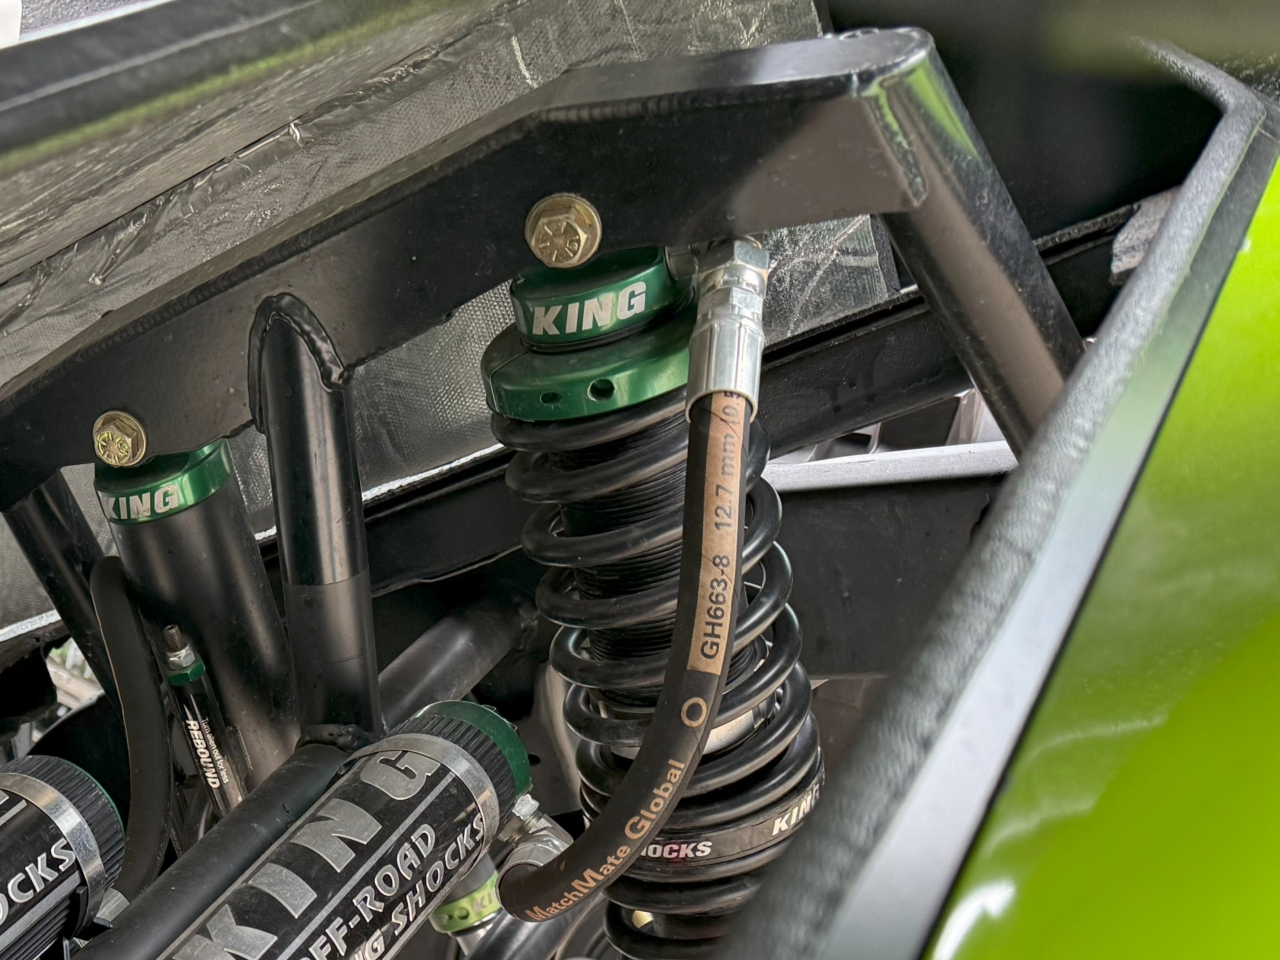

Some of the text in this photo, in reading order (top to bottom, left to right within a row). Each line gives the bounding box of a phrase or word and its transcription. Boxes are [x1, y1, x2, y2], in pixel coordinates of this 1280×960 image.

[532, 281, 647, 336] KING
[98, 484, 180, 520] KING
[713, 484, 734, 532] 12.7
[699, 554, 731, 661] GH663-8
[185, 719, 220, 789] REBOUND
[525, 845, 631, 922] MatchMate
[624, 758, 685, 840] Global
[391, 814, 486, 937] SHOCKS
